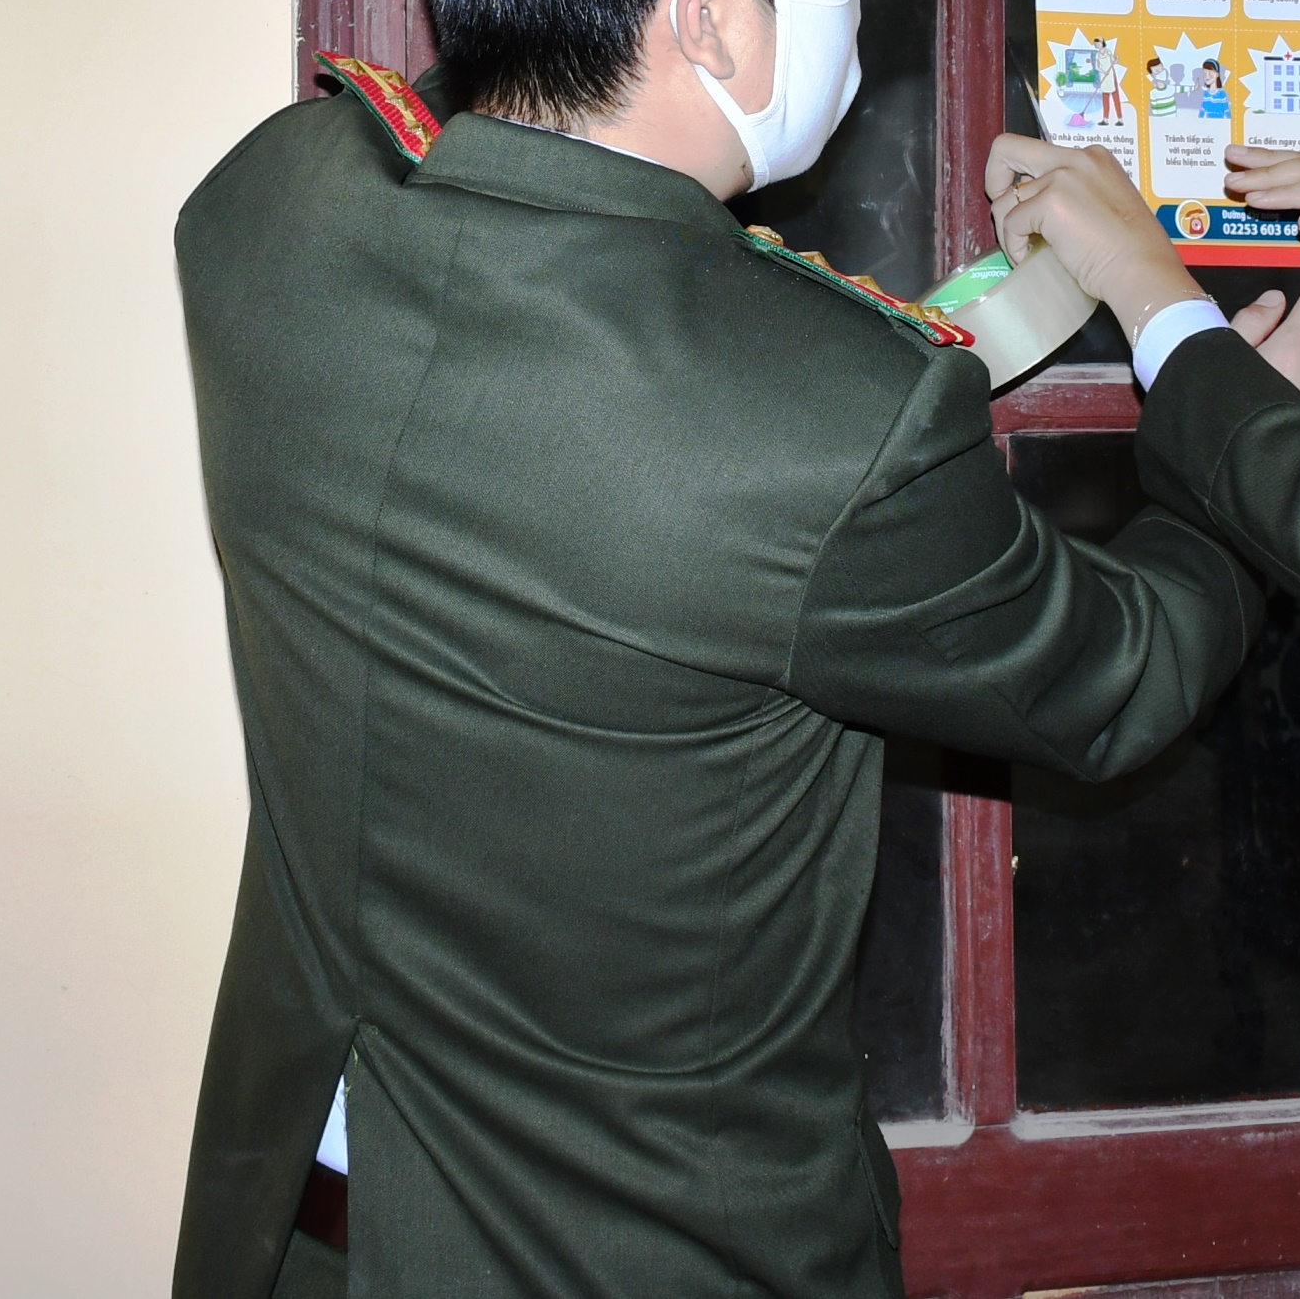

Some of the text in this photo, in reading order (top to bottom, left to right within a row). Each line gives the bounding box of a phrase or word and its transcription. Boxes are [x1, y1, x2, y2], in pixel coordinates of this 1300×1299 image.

[1058, 133, 1071, 141] nhà
[1073, 133, 1085, 141] cửa
[1087, 134, 1101, 143] sạch
[1113, 135, 1134, 144] thông
[1165, 135, 1214, 145] Tránh tiếp xúc
[1263, 137, 1277, 145] đến
[1279, 138, 1296, 147] ngay
[1123, 147, 1134, 155] lau
[1181, 147, 1201, 156] người
[1183, 158, 1198, 168] hiện
[1222, 210, 1246, 222] Đường
[1223, 223, 1258, 235] 02253
[1260, 223, 1281, 236] 603
